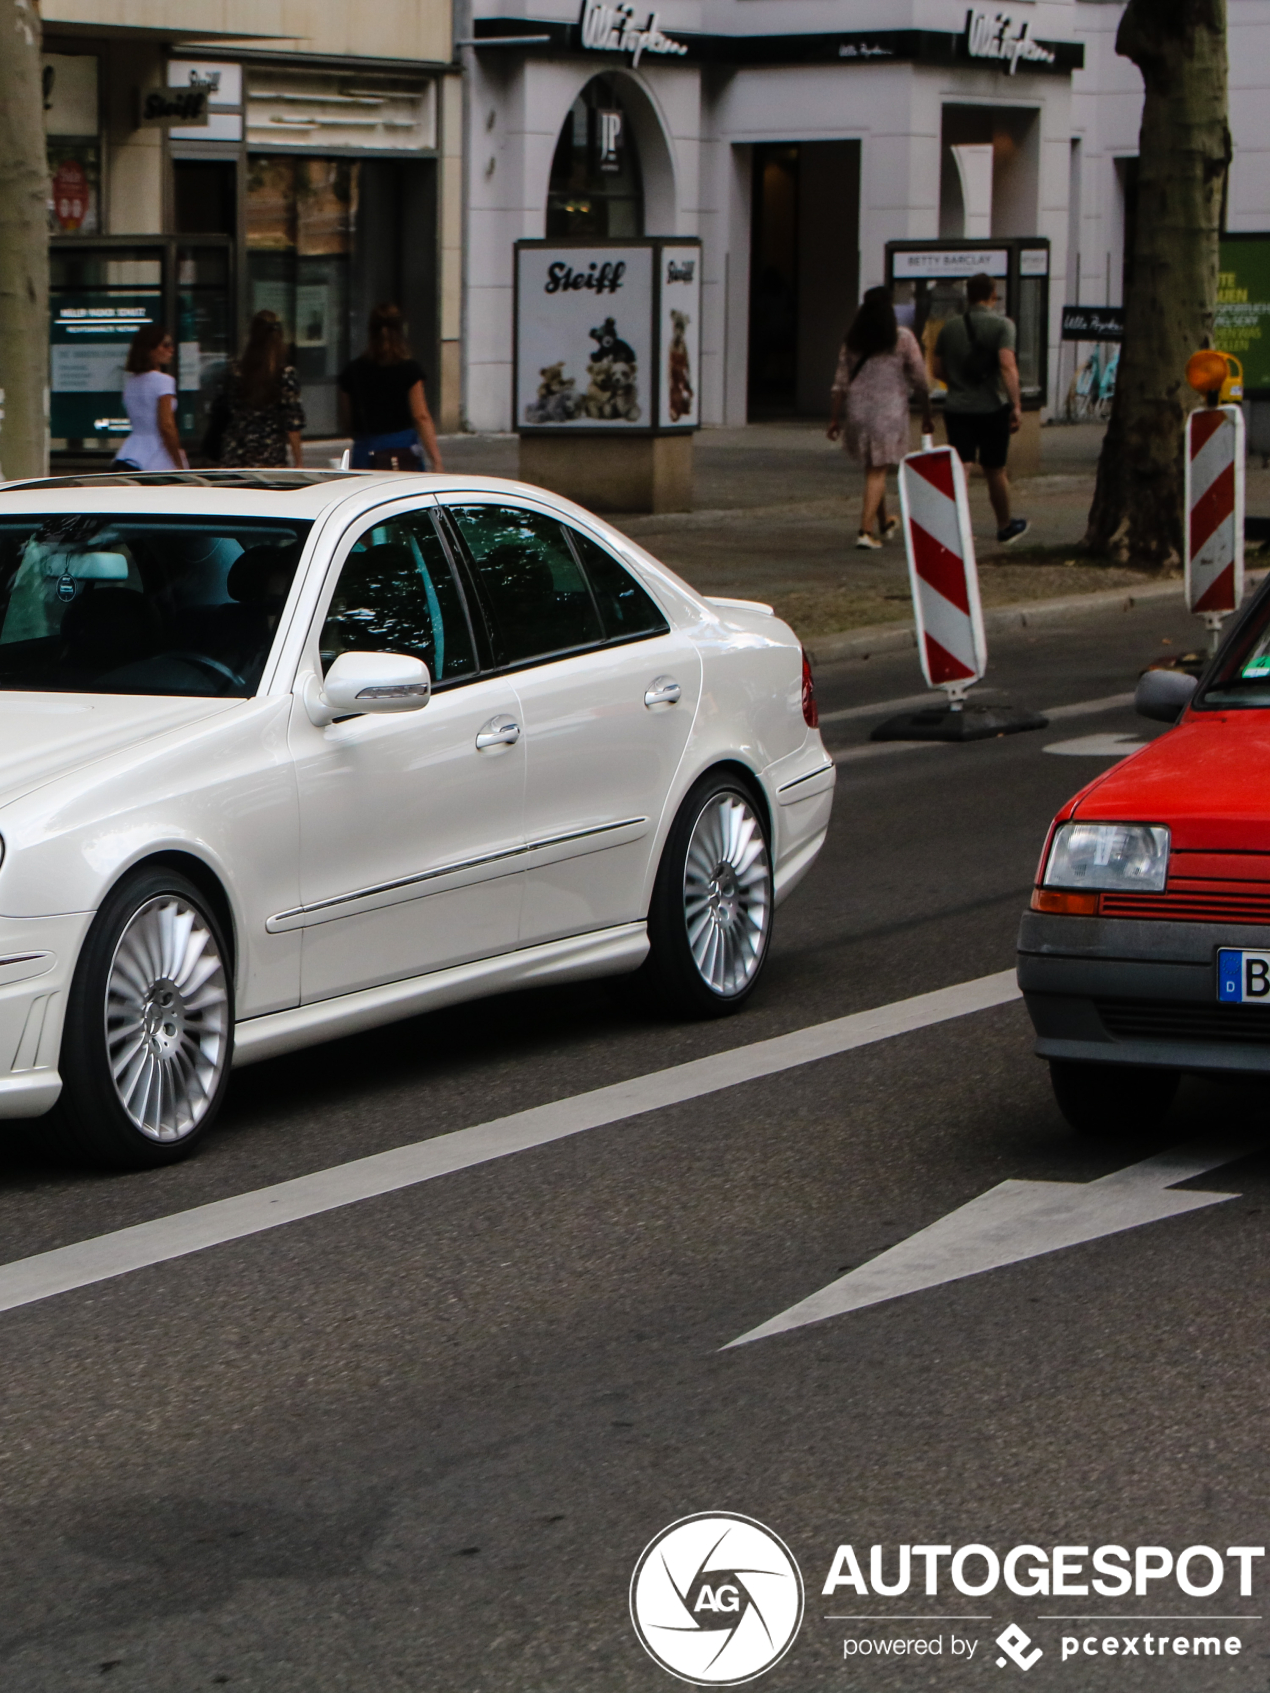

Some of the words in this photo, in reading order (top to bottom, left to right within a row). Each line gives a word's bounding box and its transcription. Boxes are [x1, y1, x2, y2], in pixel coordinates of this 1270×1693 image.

[907, 254, 939, 267] BETTY
[943, 254, 990, 267] BARCLAY
[545, 261, 627, 295] Steiff
[1226, 980, 1235, 993] D
[1245, 958, 1270, 997] B
